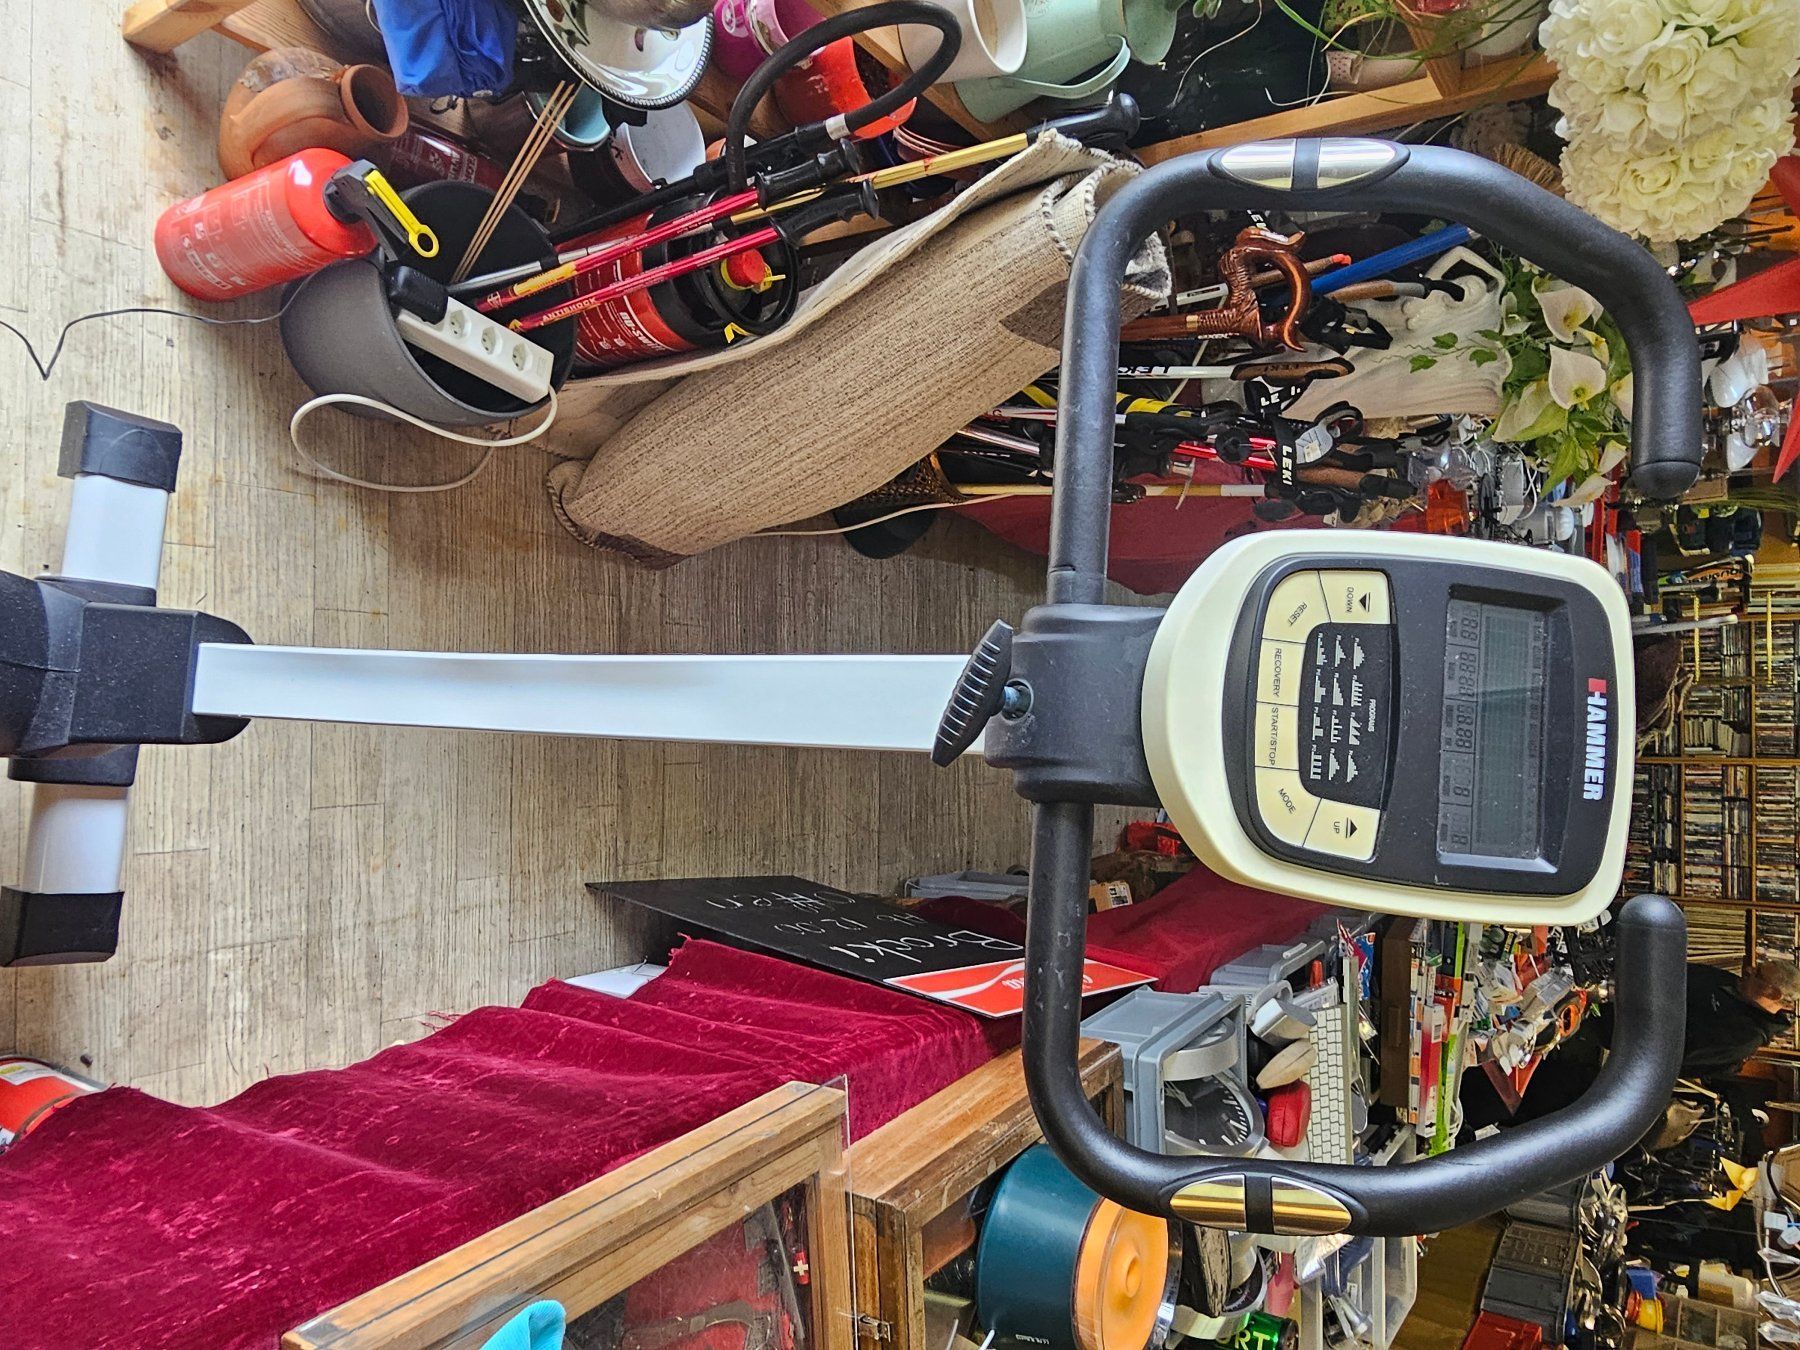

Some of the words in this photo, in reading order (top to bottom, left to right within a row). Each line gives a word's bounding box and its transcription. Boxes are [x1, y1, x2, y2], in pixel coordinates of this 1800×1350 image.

[1282, 445, 1293, 486] LEKI
[1287, 602, 1308, 627] RESET
[1345, 586, 1355, 613] DOWN
[1272, 647, 1282, 698] RECOVERY
[1367, 699, 1377, 732] PROGRAMS
[1268, 706, 1280, 766] START/STOP
[1583, 678, 1607, 801] HAMMER
[1278, 788, 1297, 813] MODE
[1333, 821, 1340, 834] UP
[828, 928, 1024, 963] Brocki
